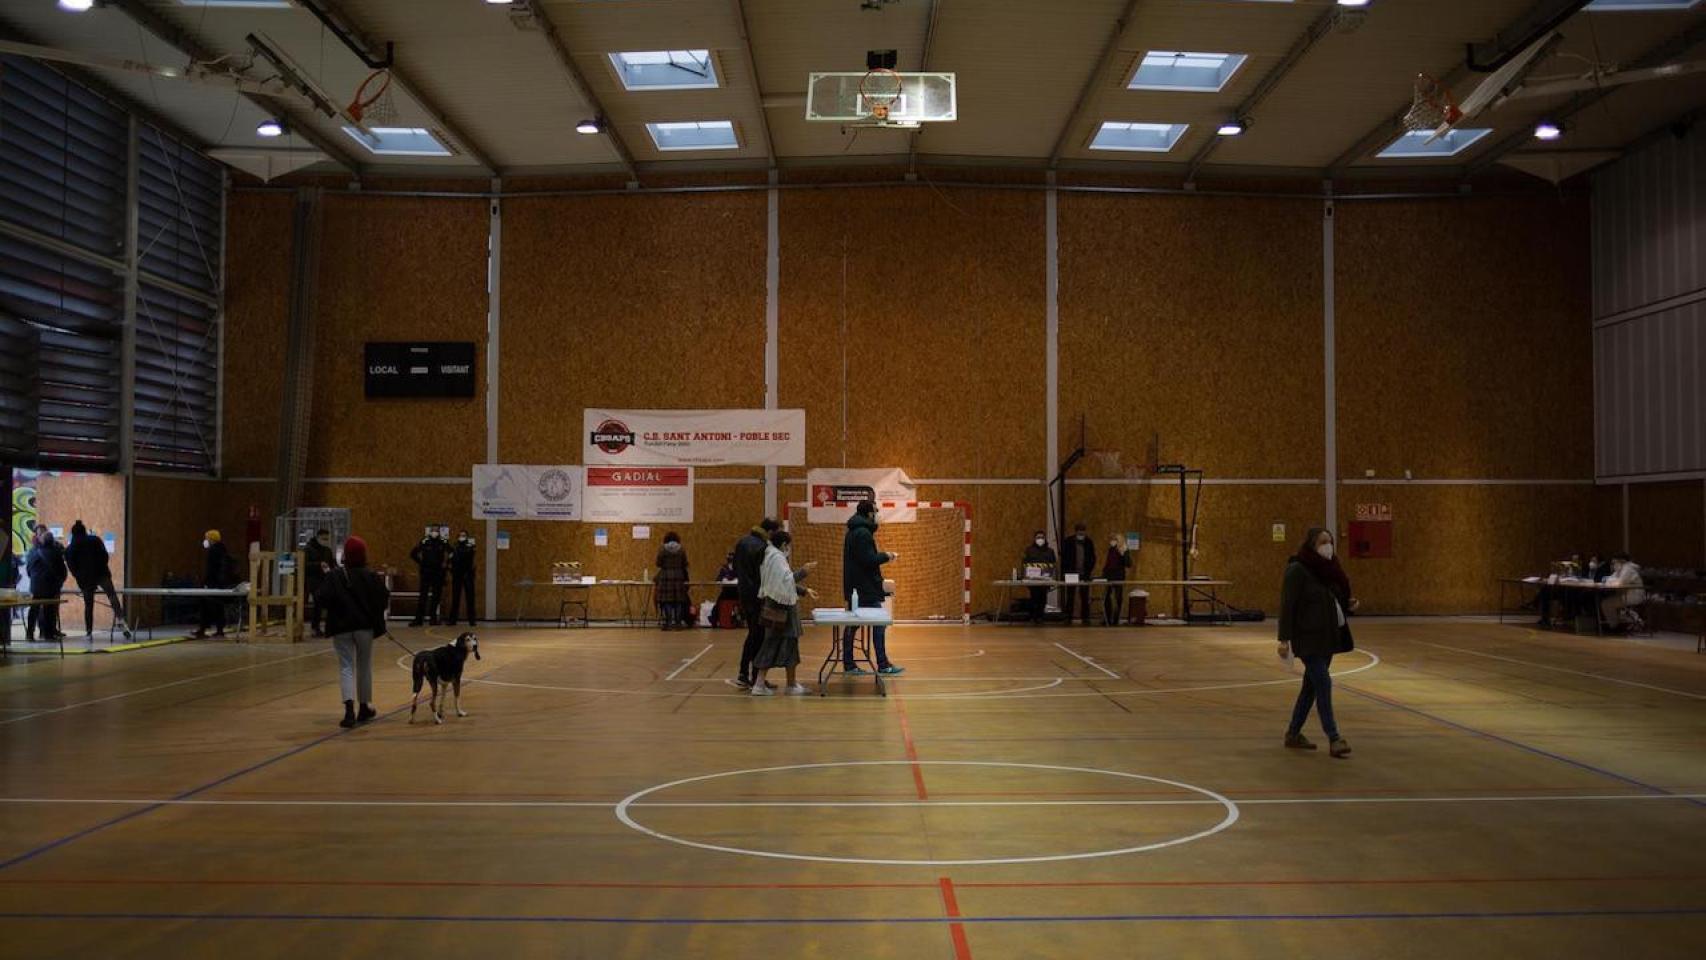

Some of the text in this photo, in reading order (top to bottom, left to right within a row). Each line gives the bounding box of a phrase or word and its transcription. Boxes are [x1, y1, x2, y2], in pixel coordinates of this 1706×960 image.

[369, 365, 399, 374] LOCAL
[441, 364, 470, 374] VISITANT
[663, 432, 691, 441] SANT
[693, 432, 731, 441] ANTONI
[740, 432, 770, 441] POBLE
[772, 432, 791, 441] SEC
[611, 471, 662, 481] GADIAL
